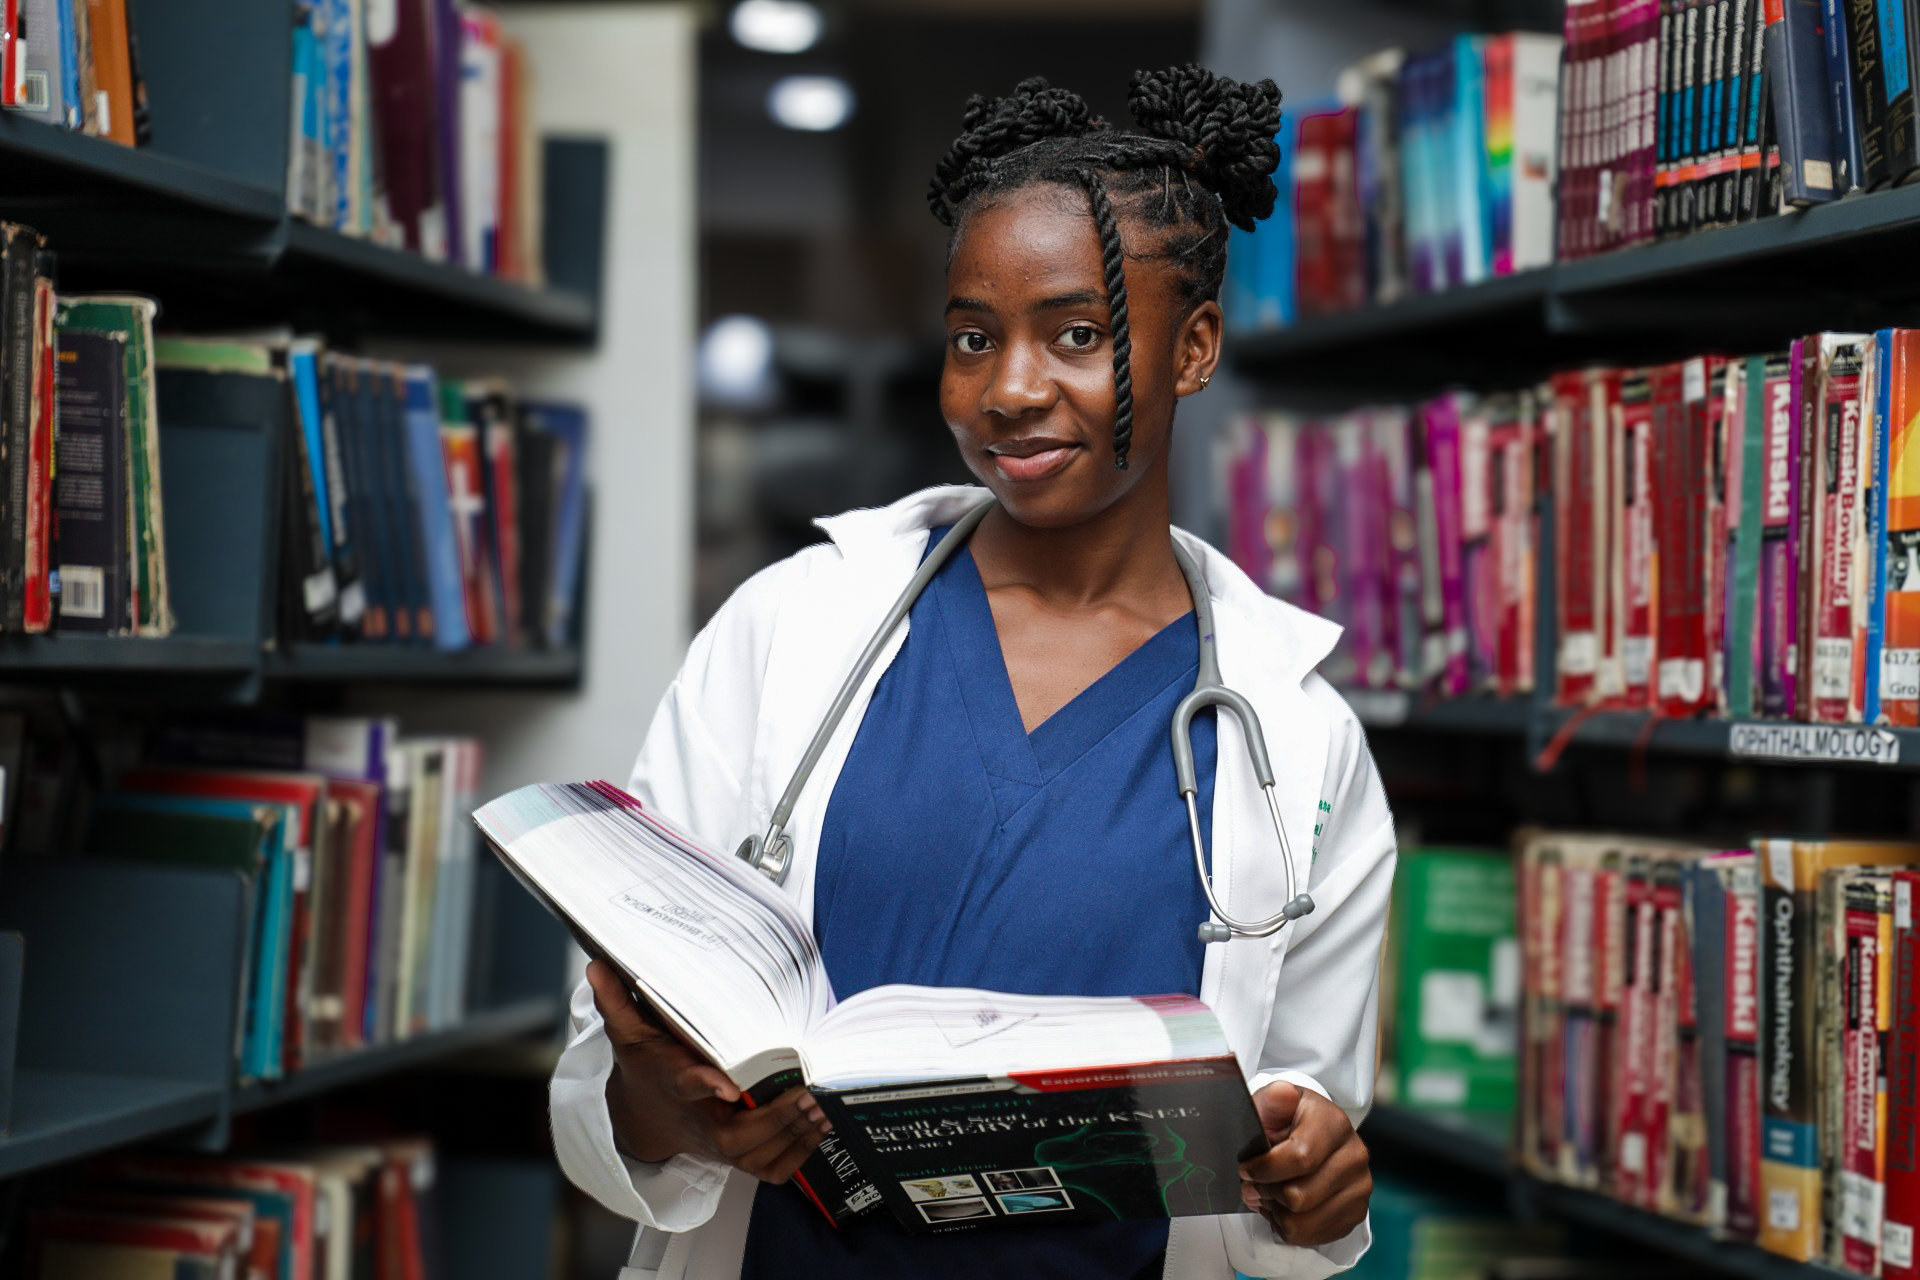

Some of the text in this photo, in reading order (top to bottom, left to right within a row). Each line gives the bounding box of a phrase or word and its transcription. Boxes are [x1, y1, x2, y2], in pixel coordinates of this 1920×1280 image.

[1853, 0, 1876, 81] RNEA
[1768, 383, 1791, 519] Kanski
[1873, 414, 1883, 476] Primary
[1871, 481, 1881, 517] Care
[1734, 728, 1897, 758] OPHTHALMOLOGY
[1732, 898, 1757, 1032] Kanski
[1771, 897, 1795, 1111] Ophthalmology
[1041, 1068, 1215, 1086] ExpertConsult.com
[870, 1106, 1200, 1143] SURGERY of the KNEE
[876, 1141, 943, 1153] VOLUME
[827, 1148, 861, 1183] KNEE
[940, 1163, 997, 1174] Edition
